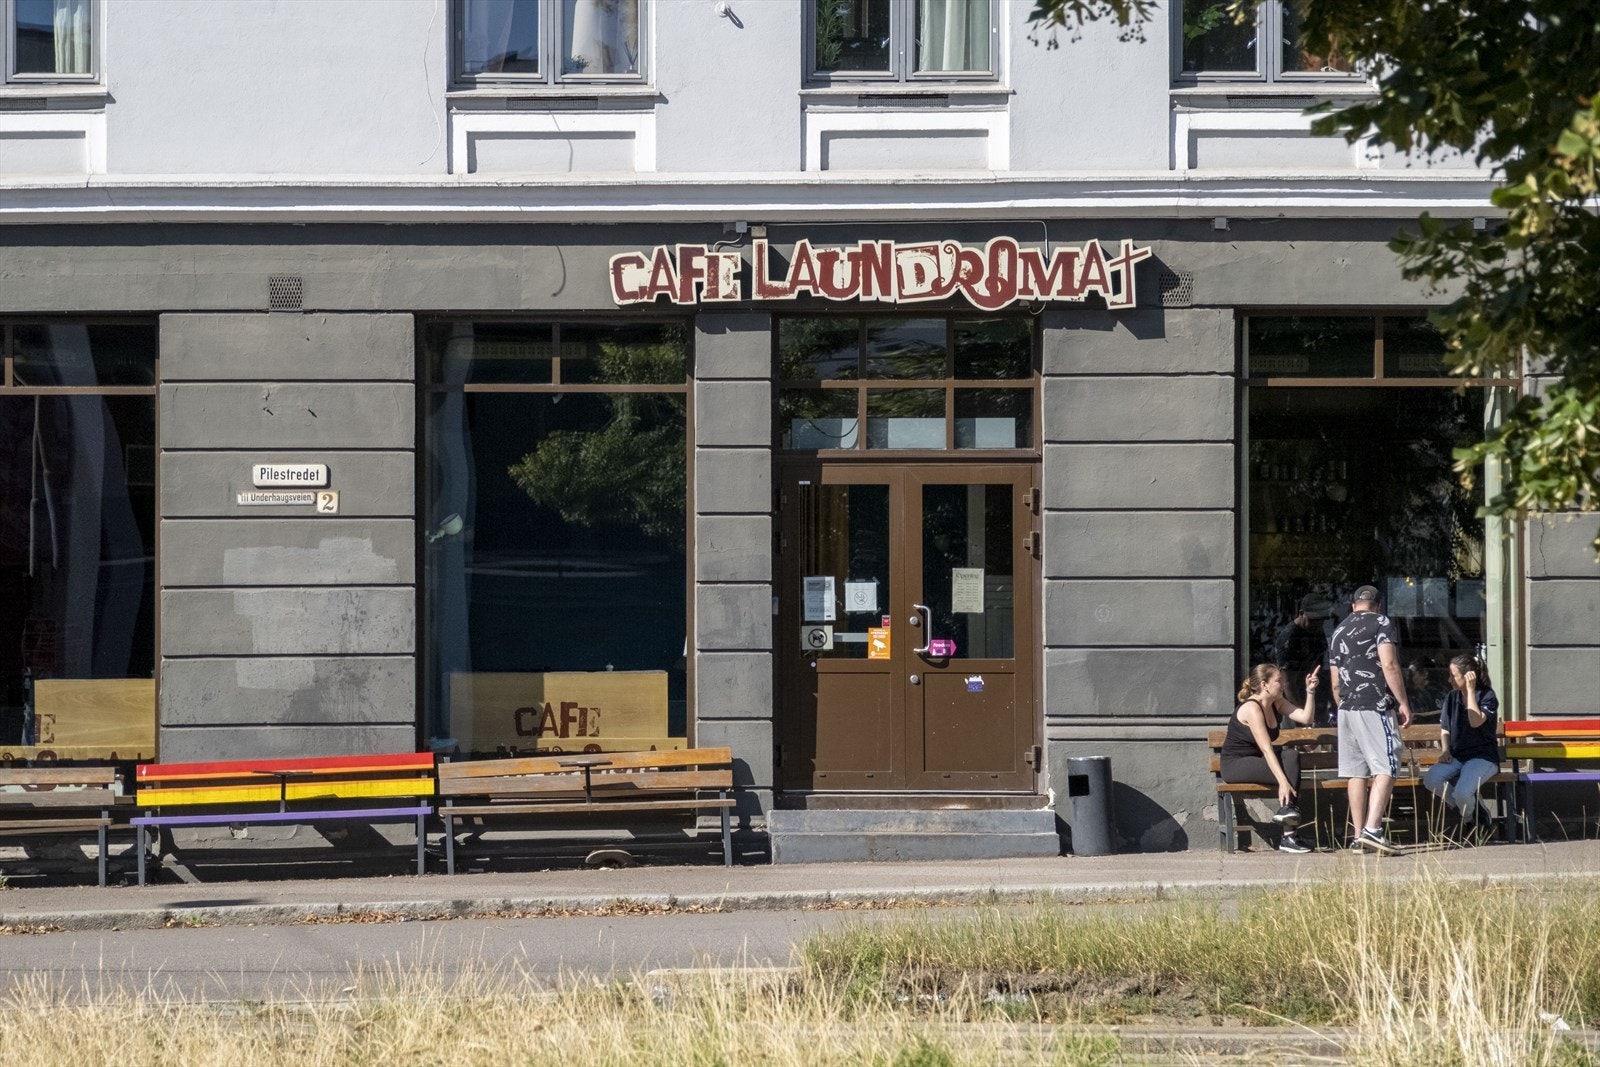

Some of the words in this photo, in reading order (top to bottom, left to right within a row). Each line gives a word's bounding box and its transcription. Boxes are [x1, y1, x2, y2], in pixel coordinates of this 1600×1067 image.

[611, 245, 740, 303] CAFE
[755, 238, 1150, 309] LAUNDROMAT
[260, 468, 319, 480] Pilestredet
[322, 493, 334, 510] 2
[514, 702, 600, 738] CAFE
